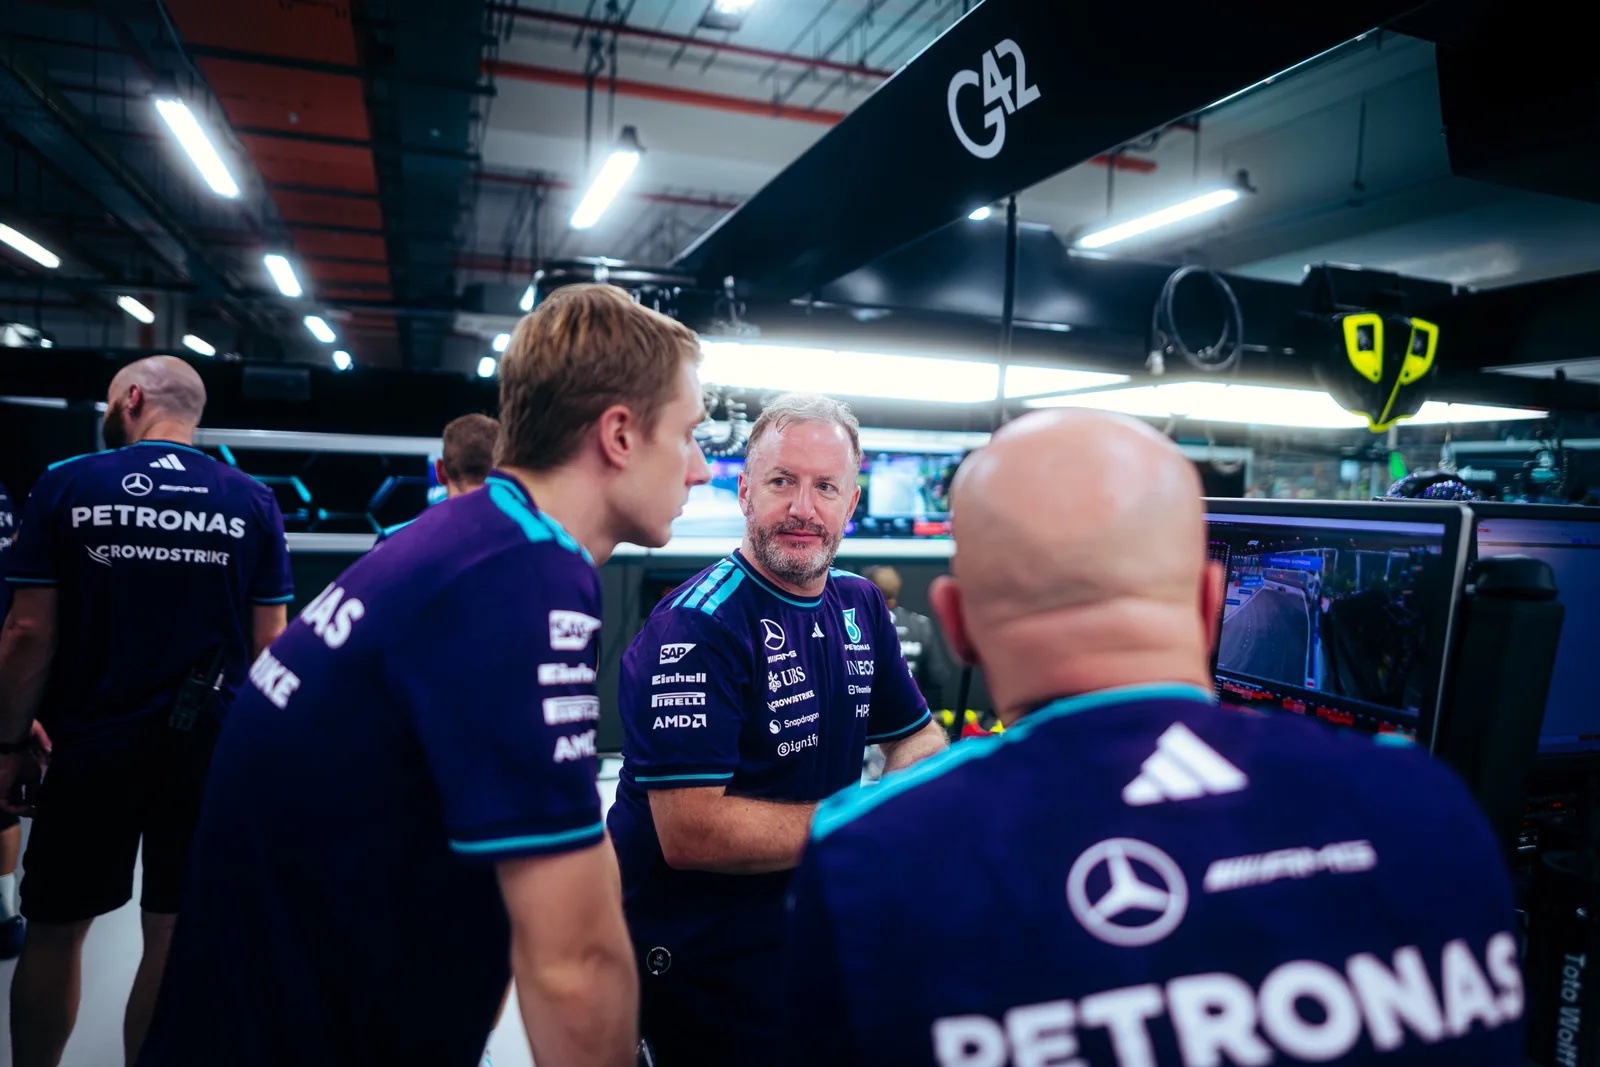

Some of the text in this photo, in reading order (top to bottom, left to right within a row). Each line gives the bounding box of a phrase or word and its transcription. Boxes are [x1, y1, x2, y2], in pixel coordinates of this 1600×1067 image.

[947, 38, 1041, 159] G42
[71, 504, 246, 539] PETRONAS
[96, 544, 230, 566] CROWDSTRIKE
[660, 645, 688, 661] SAP
[772, 650, 798, 662] AMG
[780, 666, 806, 686] UBS
[846, 660, 875, 675] INEOS
[651, 672, 707, 686] Einhell
[651, 692, 707, 708] PIRELLI
[652, 714, 692, 730] AMD
[783, 712, 820, 729] Snapdragon
[1559, 953, 1587, 1003] Toto
[932, 930, 1525, 1067] PETRONAS
